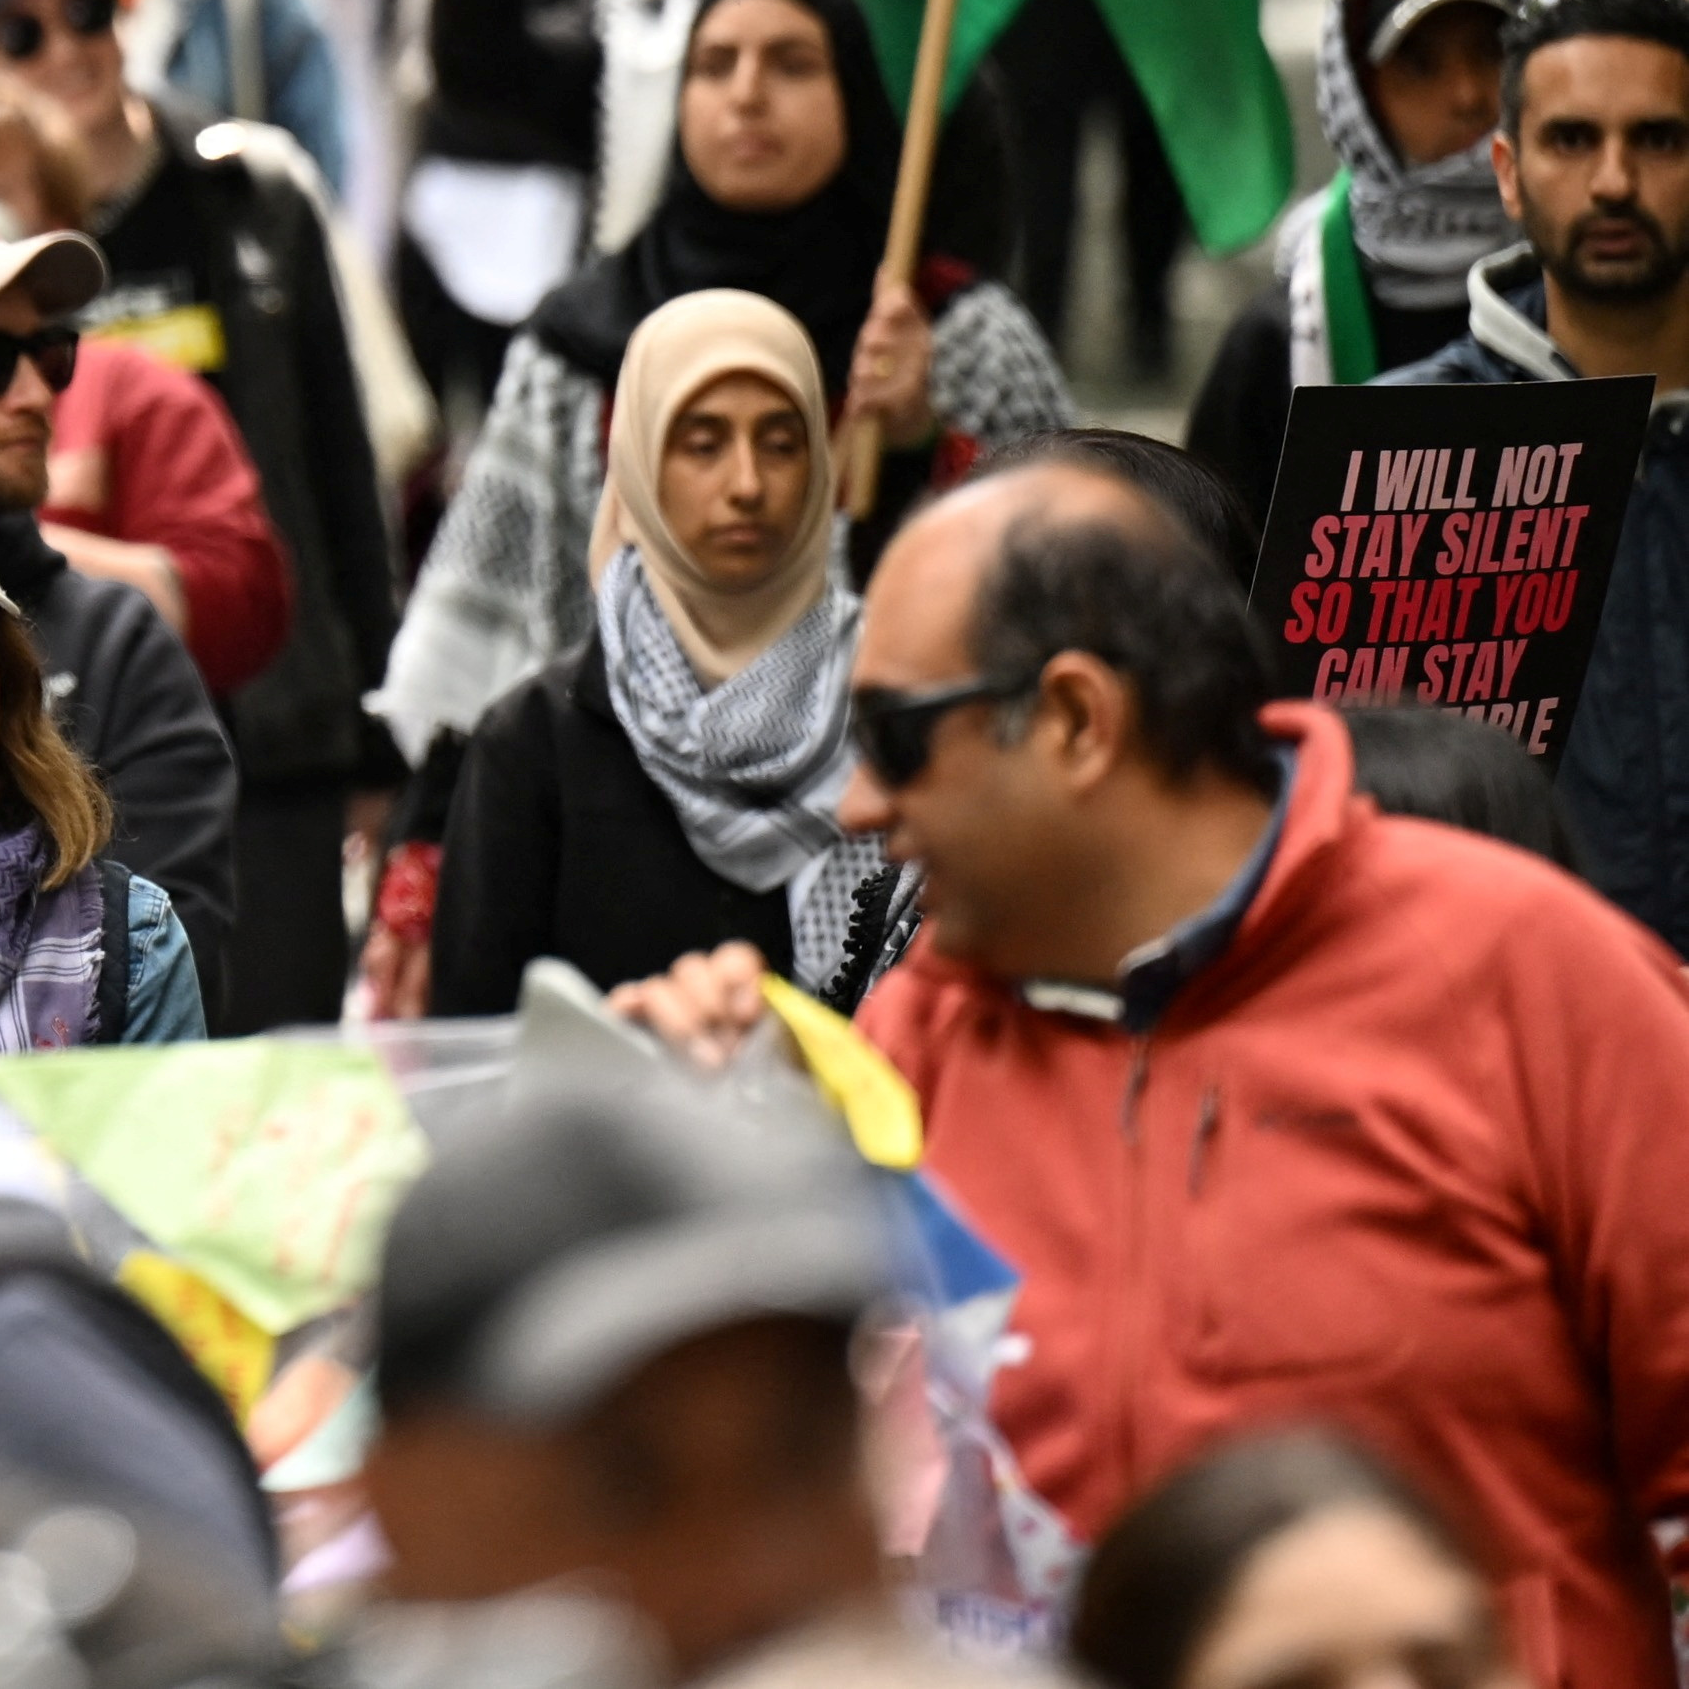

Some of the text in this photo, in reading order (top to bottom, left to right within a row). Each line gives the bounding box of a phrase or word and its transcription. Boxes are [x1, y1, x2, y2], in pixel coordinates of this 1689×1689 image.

[1340, 443, 1582, 511] I WILL NOT
[1304, 505, 1590, 578] STAY SILENT
[1284, 570, 1579, 644] SO THAT YOU
[1312, 639, 1528, 707] CAN STAY
